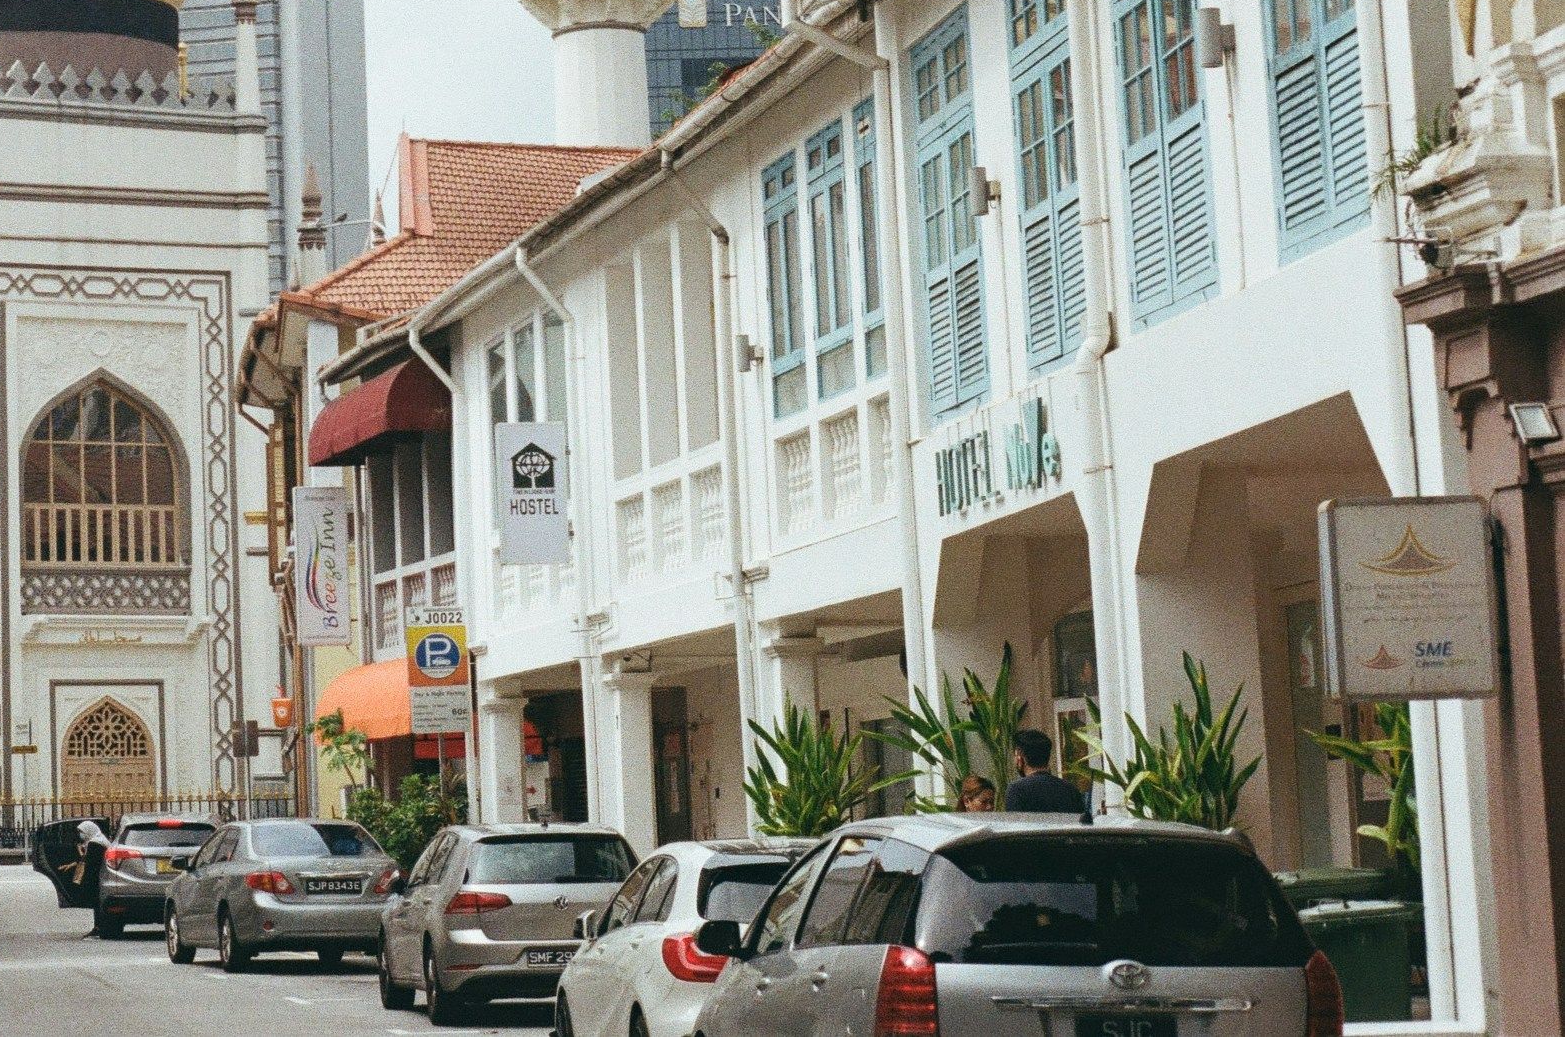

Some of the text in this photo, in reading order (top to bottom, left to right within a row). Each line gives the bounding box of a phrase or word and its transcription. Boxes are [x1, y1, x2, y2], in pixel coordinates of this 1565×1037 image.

[934, 429, 1002, 518] HOTEL
[509, 497, 560, 515] HOSTEL
[319, 507, 336, 551] Inn
[321, 557, 342, 631] Breeze
[424, 611, 463, 624] J0022
[1414, 640, 1453, 657] SME
[528, 950, 576, 963] SMF 29
